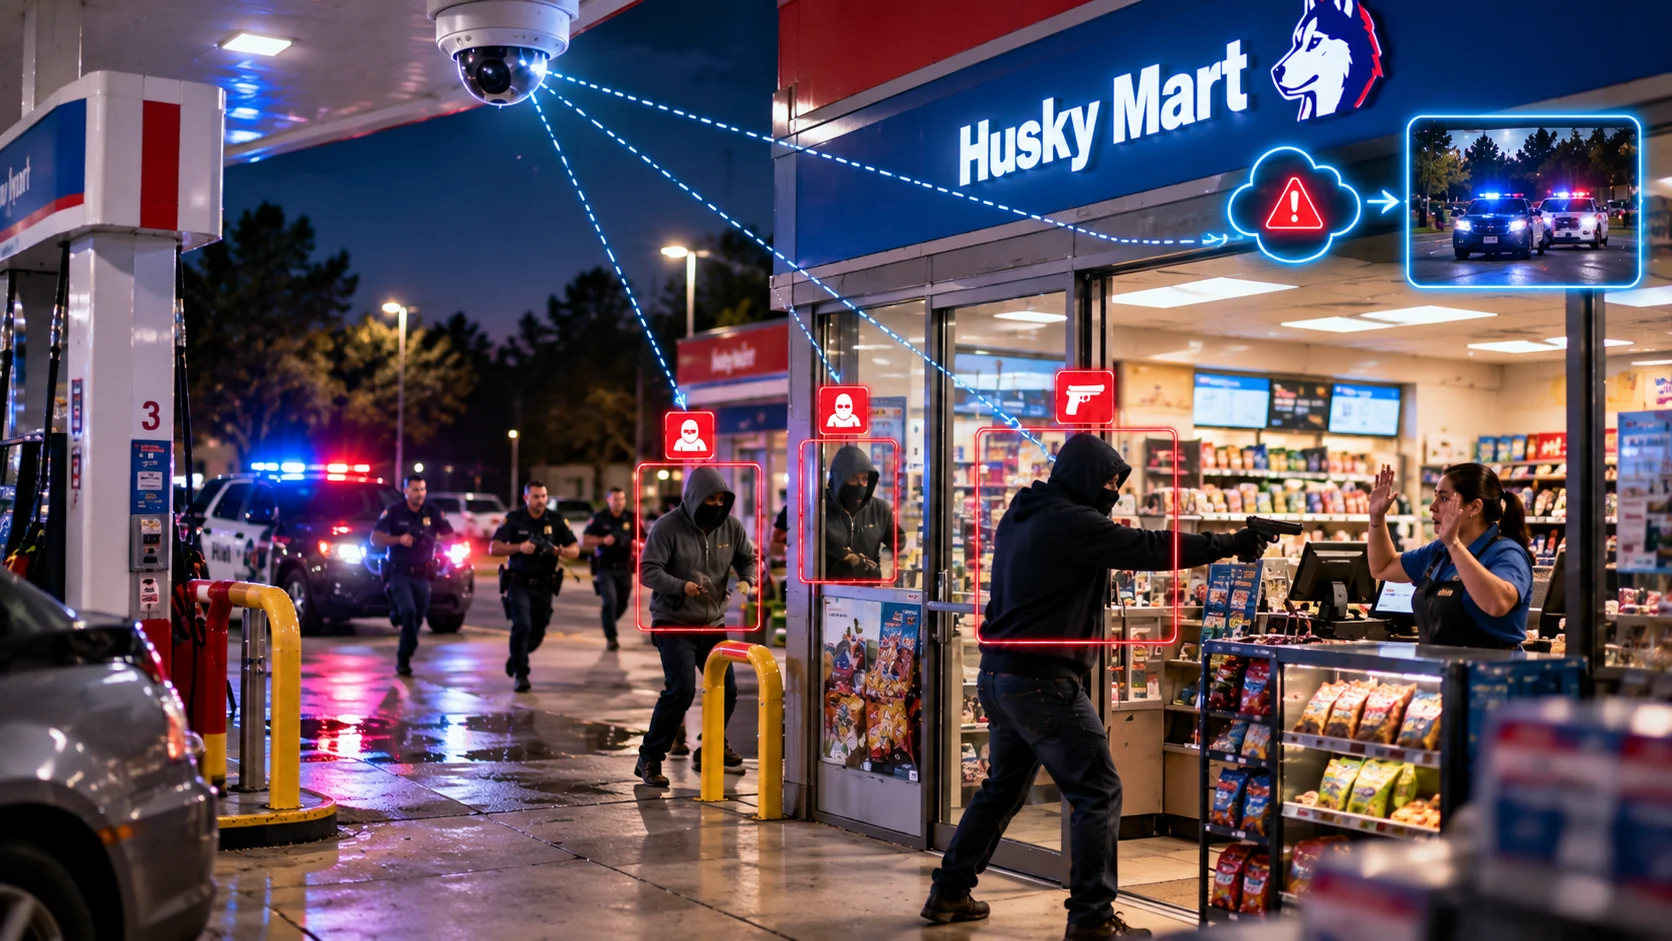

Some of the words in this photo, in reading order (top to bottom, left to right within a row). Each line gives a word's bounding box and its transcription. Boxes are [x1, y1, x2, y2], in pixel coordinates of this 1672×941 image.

[958, 97, 1101, 187] Husky
[1113, 39, 1248, 145] Mart
[141, 400, 161, 431] 3
